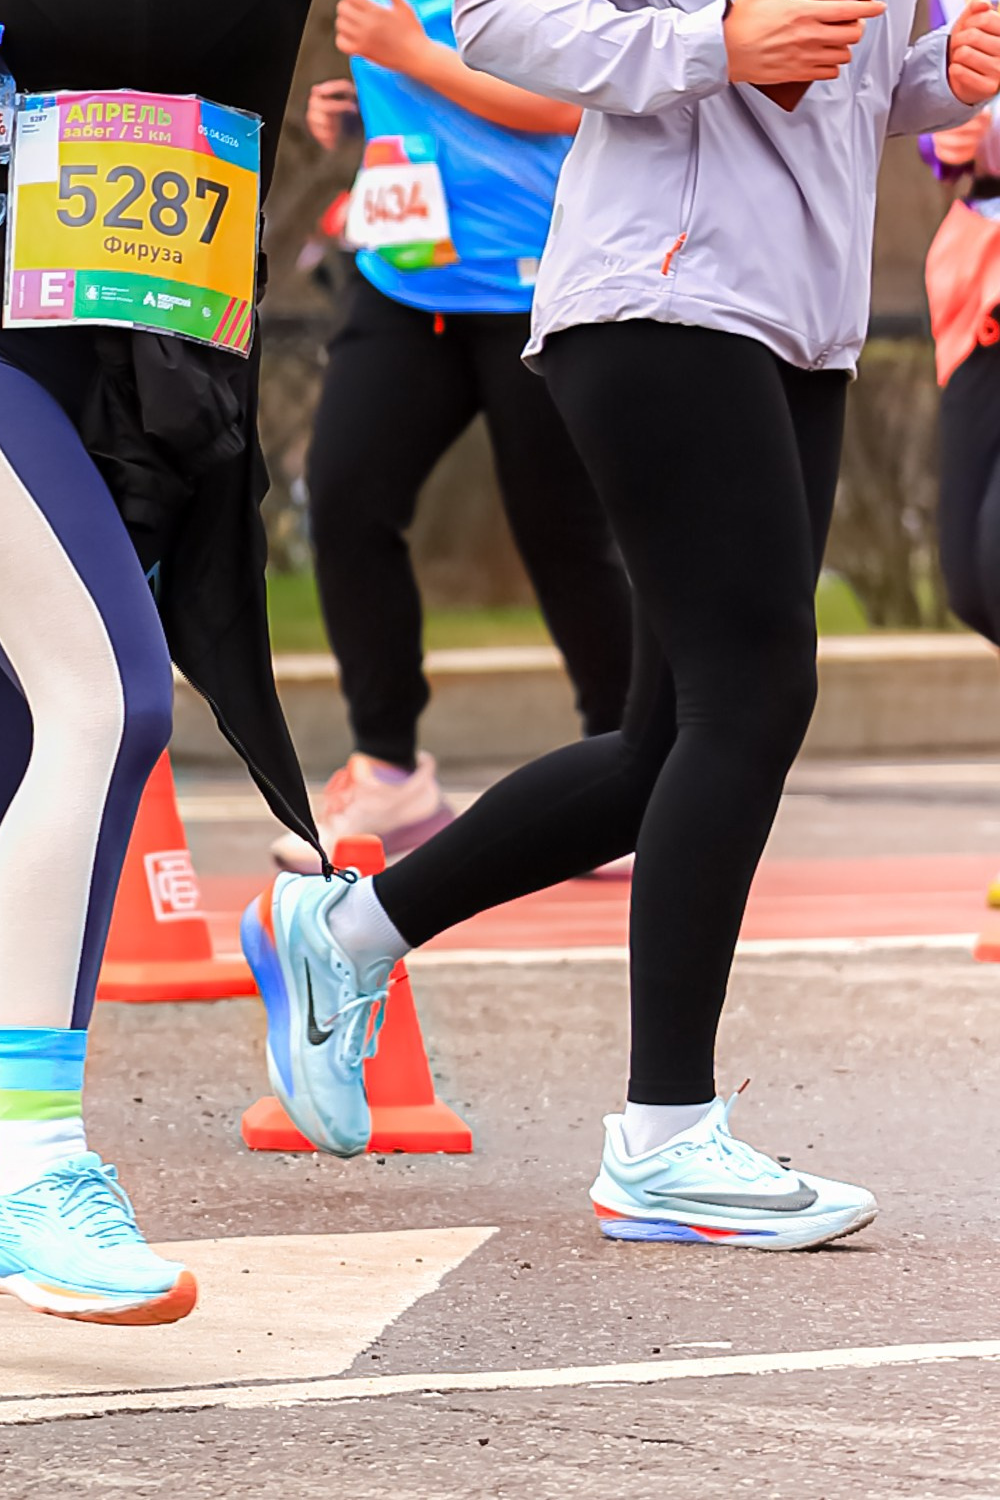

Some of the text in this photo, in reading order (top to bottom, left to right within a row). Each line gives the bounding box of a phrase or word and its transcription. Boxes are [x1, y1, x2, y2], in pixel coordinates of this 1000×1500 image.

[66, 103, 172, 126] АПРЕЛЬ
[63, 124, 115, 139] забег
[133, 126, 144, 139] 5
[148, 130, 172, 143] км
[56, 164, 230, 245] 5287
[103, 236, 183, 264] Фируза
